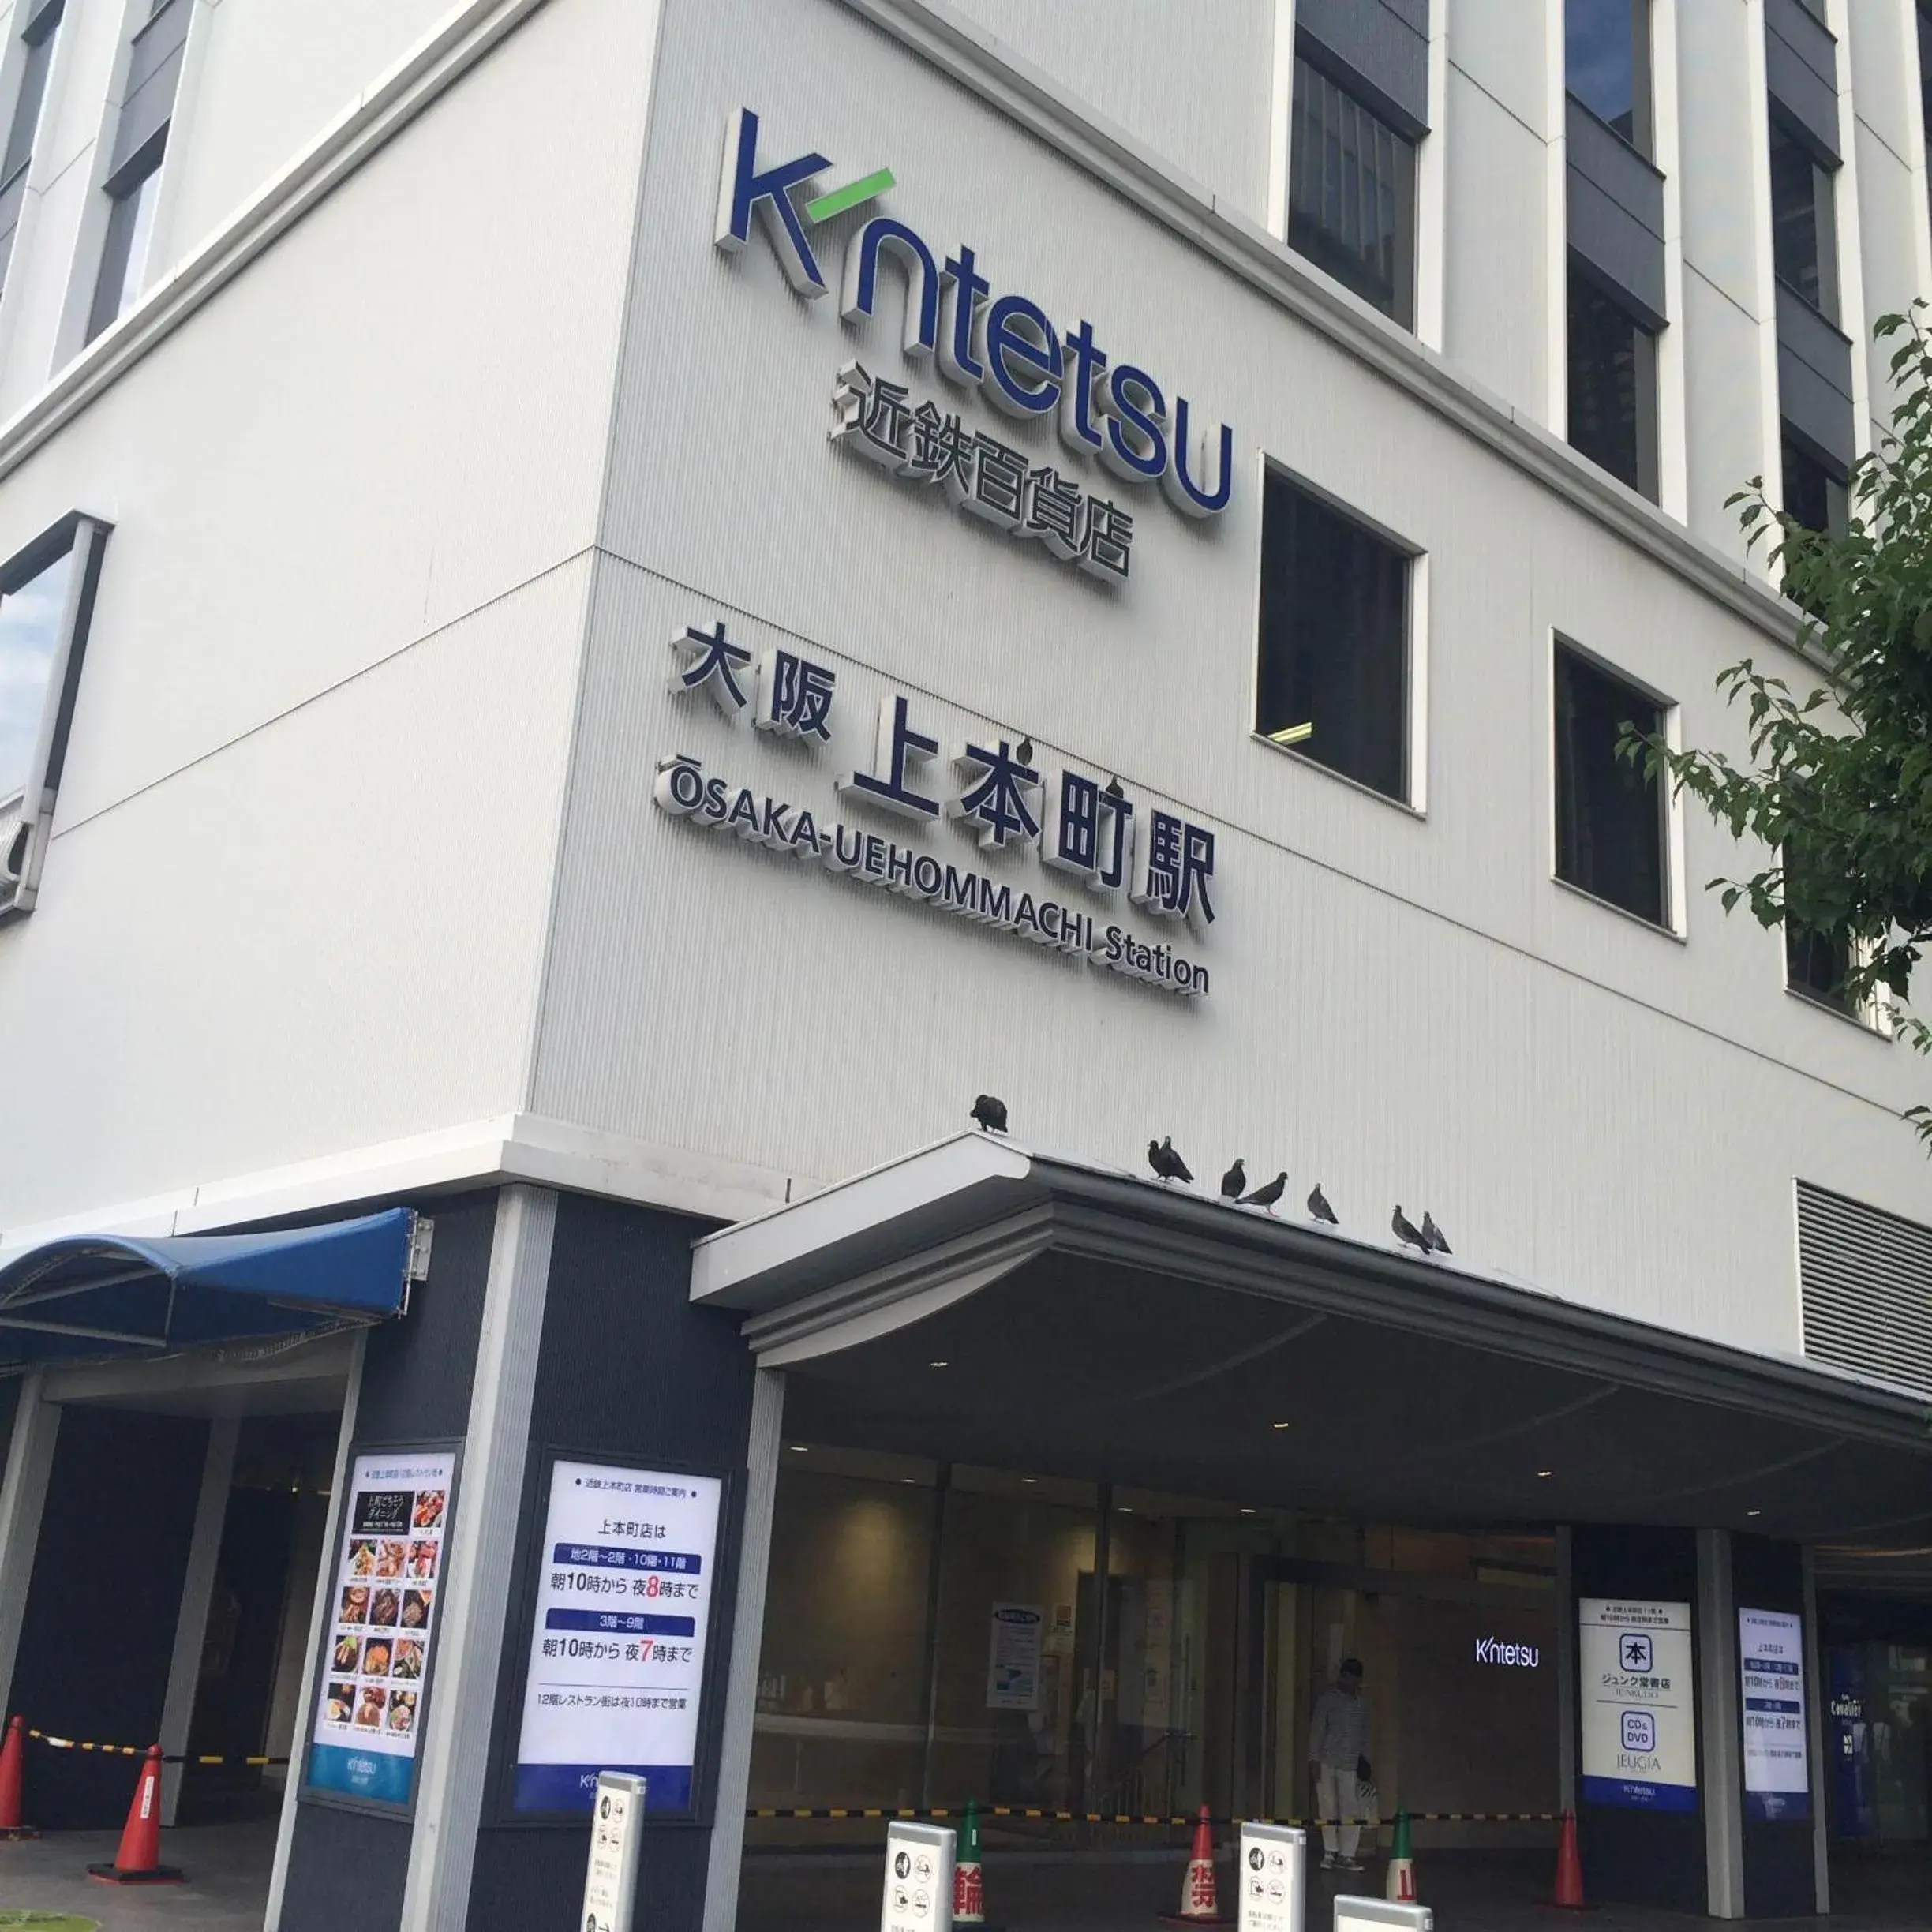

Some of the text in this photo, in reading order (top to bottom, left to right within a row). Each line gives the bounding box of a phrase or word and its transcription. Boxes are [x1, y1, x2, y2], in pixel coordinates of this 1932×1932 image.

[843, 368, 1134, 579] 近鉄百貨店
[1105, 925, 1209, 995] Station
[597, 1518, 667, 1538] 上本町店は
[550, 1572, 699, 1600] 朝10時から 夜8時まで
[542, 1638, 693, 1663] 朝10時から 夜7時まで
[1625, 1642, 1647, 1664] 本
[1602, 1672, 1671, 1690] ジュンク堂書店
[1627, 1732, 1649, 1743] DVD
